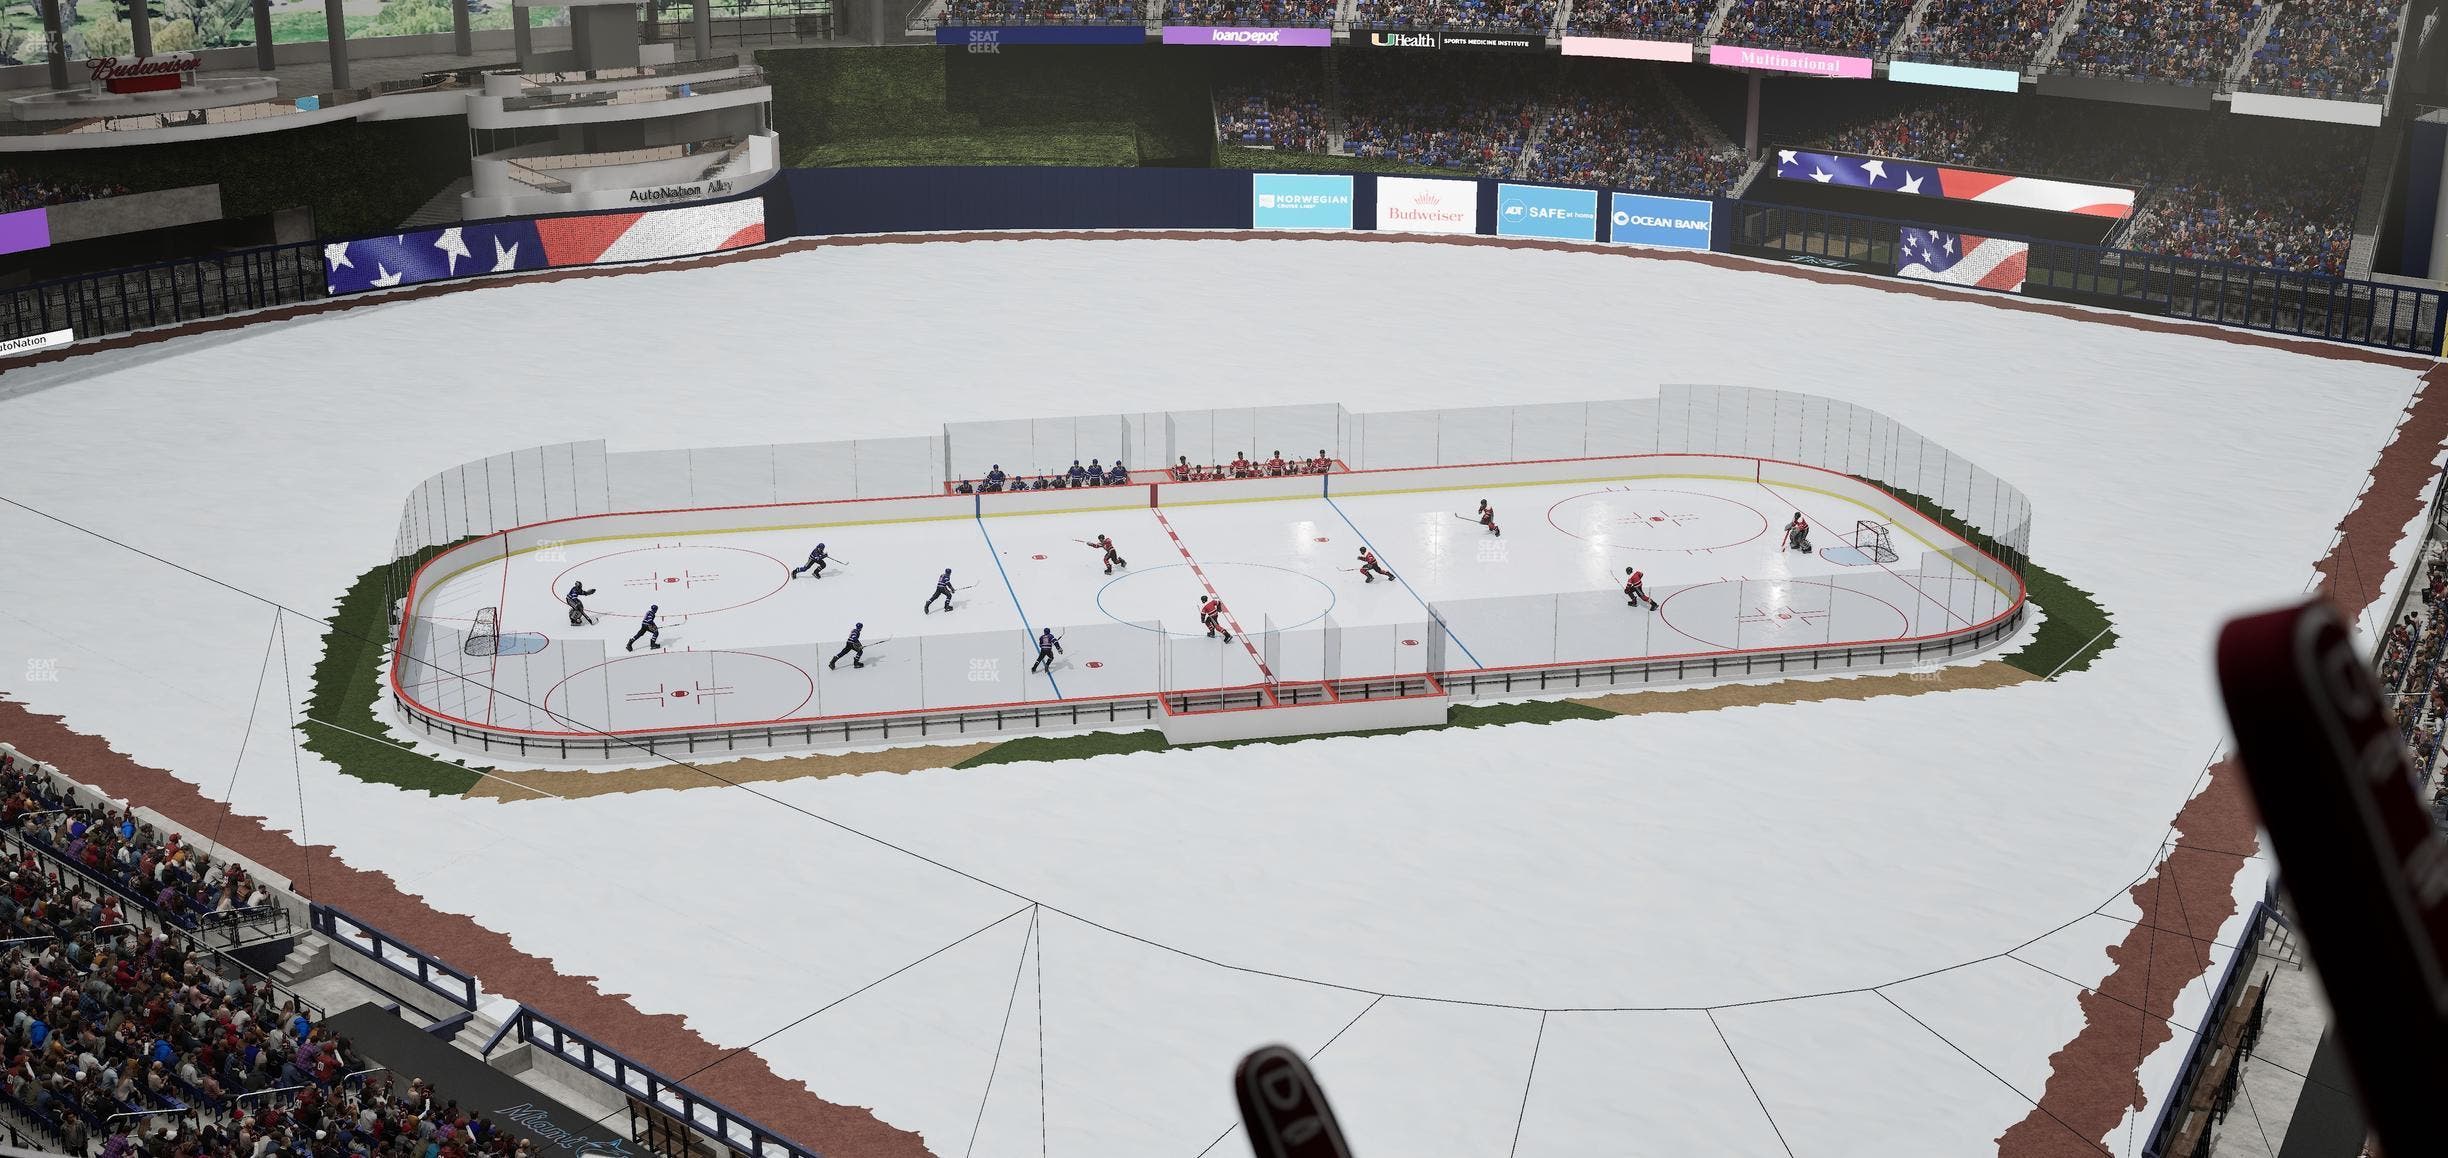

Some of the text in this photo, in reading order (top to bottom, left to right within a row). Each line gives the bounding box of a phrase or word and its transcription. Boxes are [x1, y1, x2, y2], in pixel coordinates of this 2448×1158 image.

[1212, 29, 1280, 44] loanDepot
[1371, 32, 1436, 48] UHealth
[86, 55, 202, 81] Budweiser
[1741, 51, 1840, 72] Multinational
[629, 180, 733, 202] AutoNation Alley
[1276, 194, 1348, 204] NORWEGIAN
[1388, 207, 1464, 222] Budweiser
[1504, 206, 1524, 216] ADT
[1529, 207, 1566, 219] SAFE
[1630, 215, 1709, 231] OCEAN BANK
[493, 1102, 588, 1149] Miami
